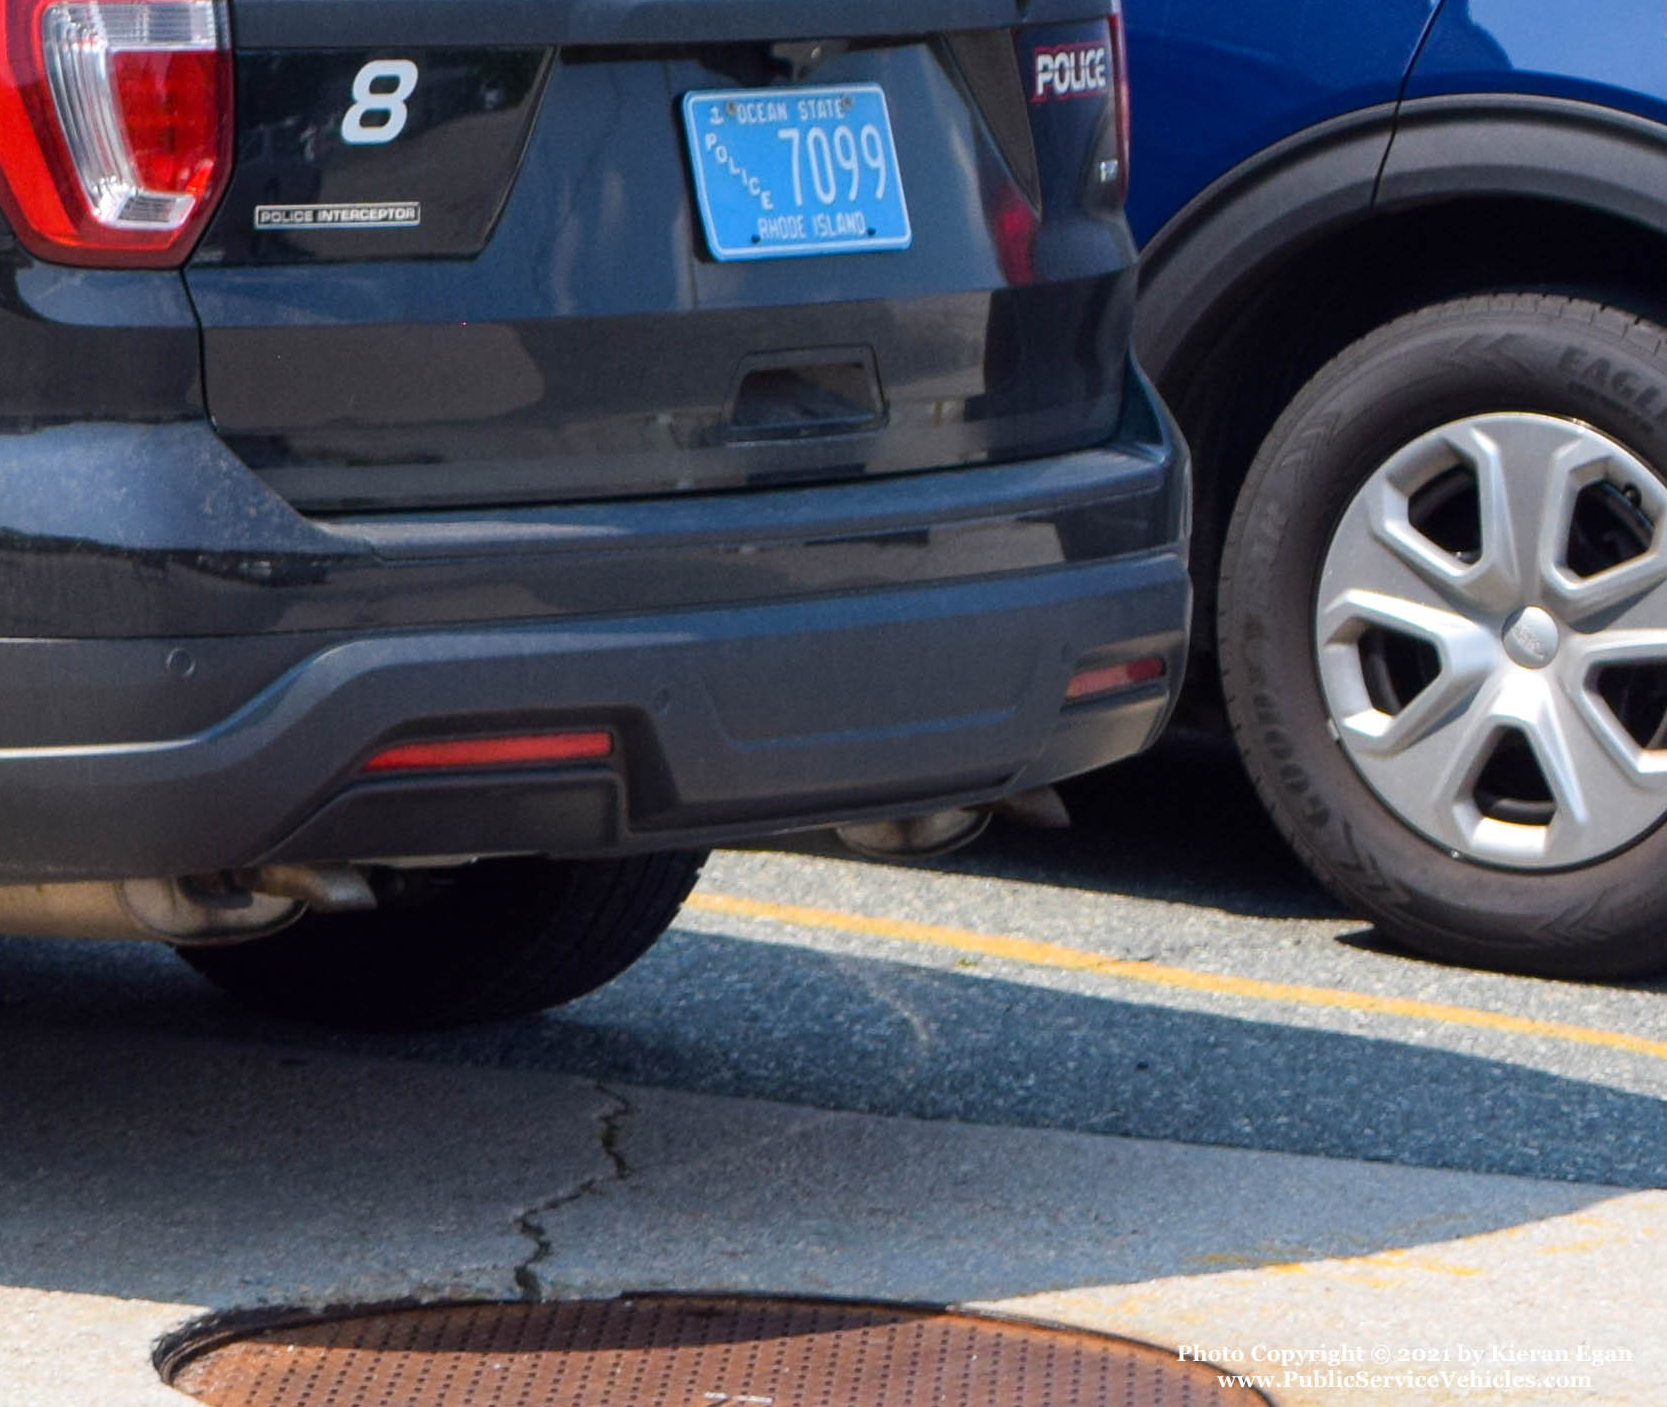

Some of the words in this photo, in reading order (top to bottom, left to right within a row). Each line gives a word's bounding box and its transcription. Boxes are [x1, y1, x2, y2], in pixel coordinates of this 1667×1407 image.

[1036, 47, 1107, 96] POLICE
[341, 59, 419, 145] 8
[736, 101, 788, 124] OCEAN
[798, 98, 846, 121] STATE
[705, 132, 775, 211] POLICE
[777, 124, 887, 207] 7099
[260, 210, 315, 224] POLICE
[317, 206, 416, 223] INTERCEPTOR
[757, 213, 807, 240] RHODE
[811, 211, 867, 237] ISLAND
